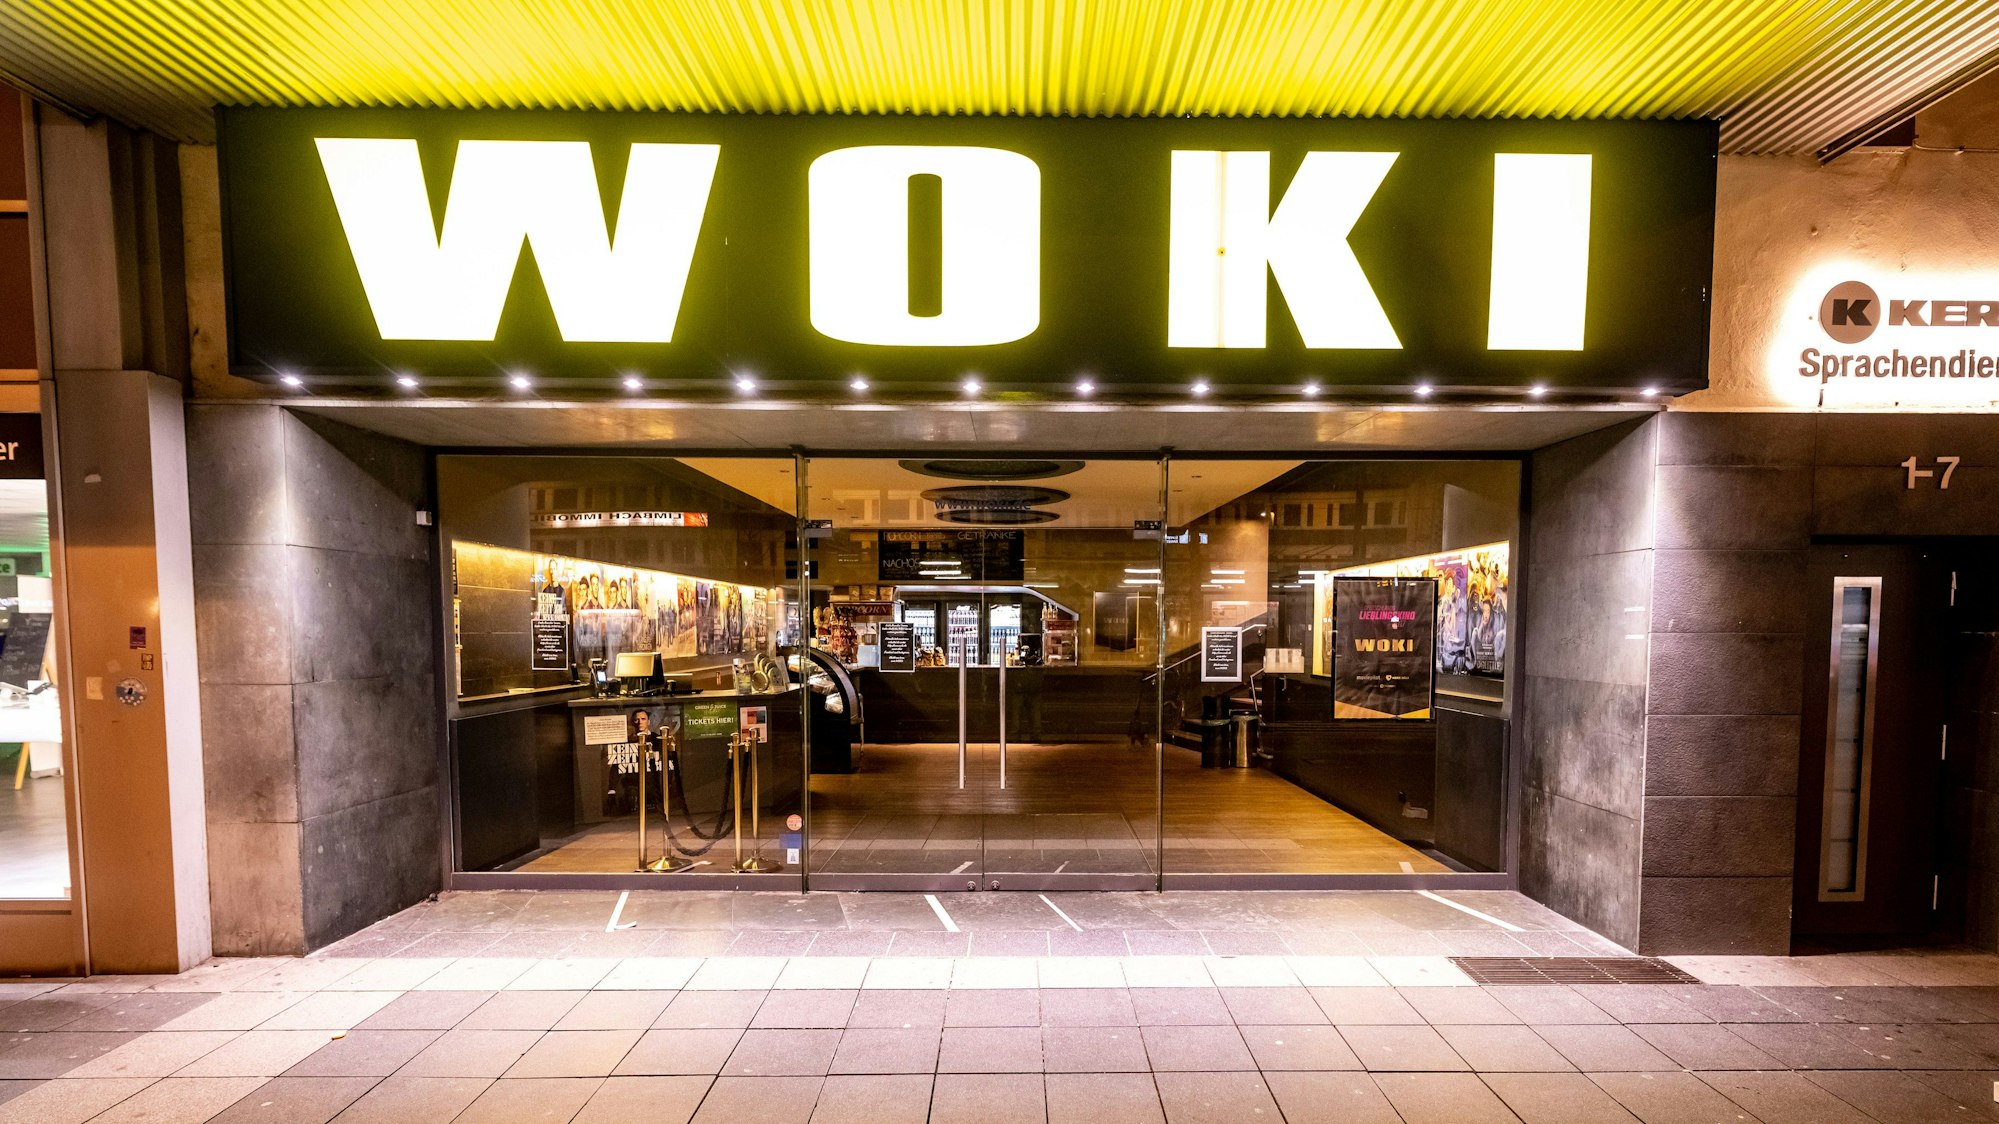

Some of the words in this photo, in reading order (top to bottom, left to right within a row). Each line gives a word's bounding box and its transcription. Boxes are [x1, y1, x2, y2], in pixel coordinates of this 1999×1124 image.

[312, 136, 1594, 351] WOKI
[1799, 347, 1999, 384] Sprachendie
[1901, 456, 1960, 489] 1-7
[882, 557, 922, 569] NACHOS
[1354, 639, 1414, 652] WOKI
[687, 718, 715, 726] TICKETS
[716, 716, 734, 724] HIER!
[607, 743, 641, 755] KEIN
